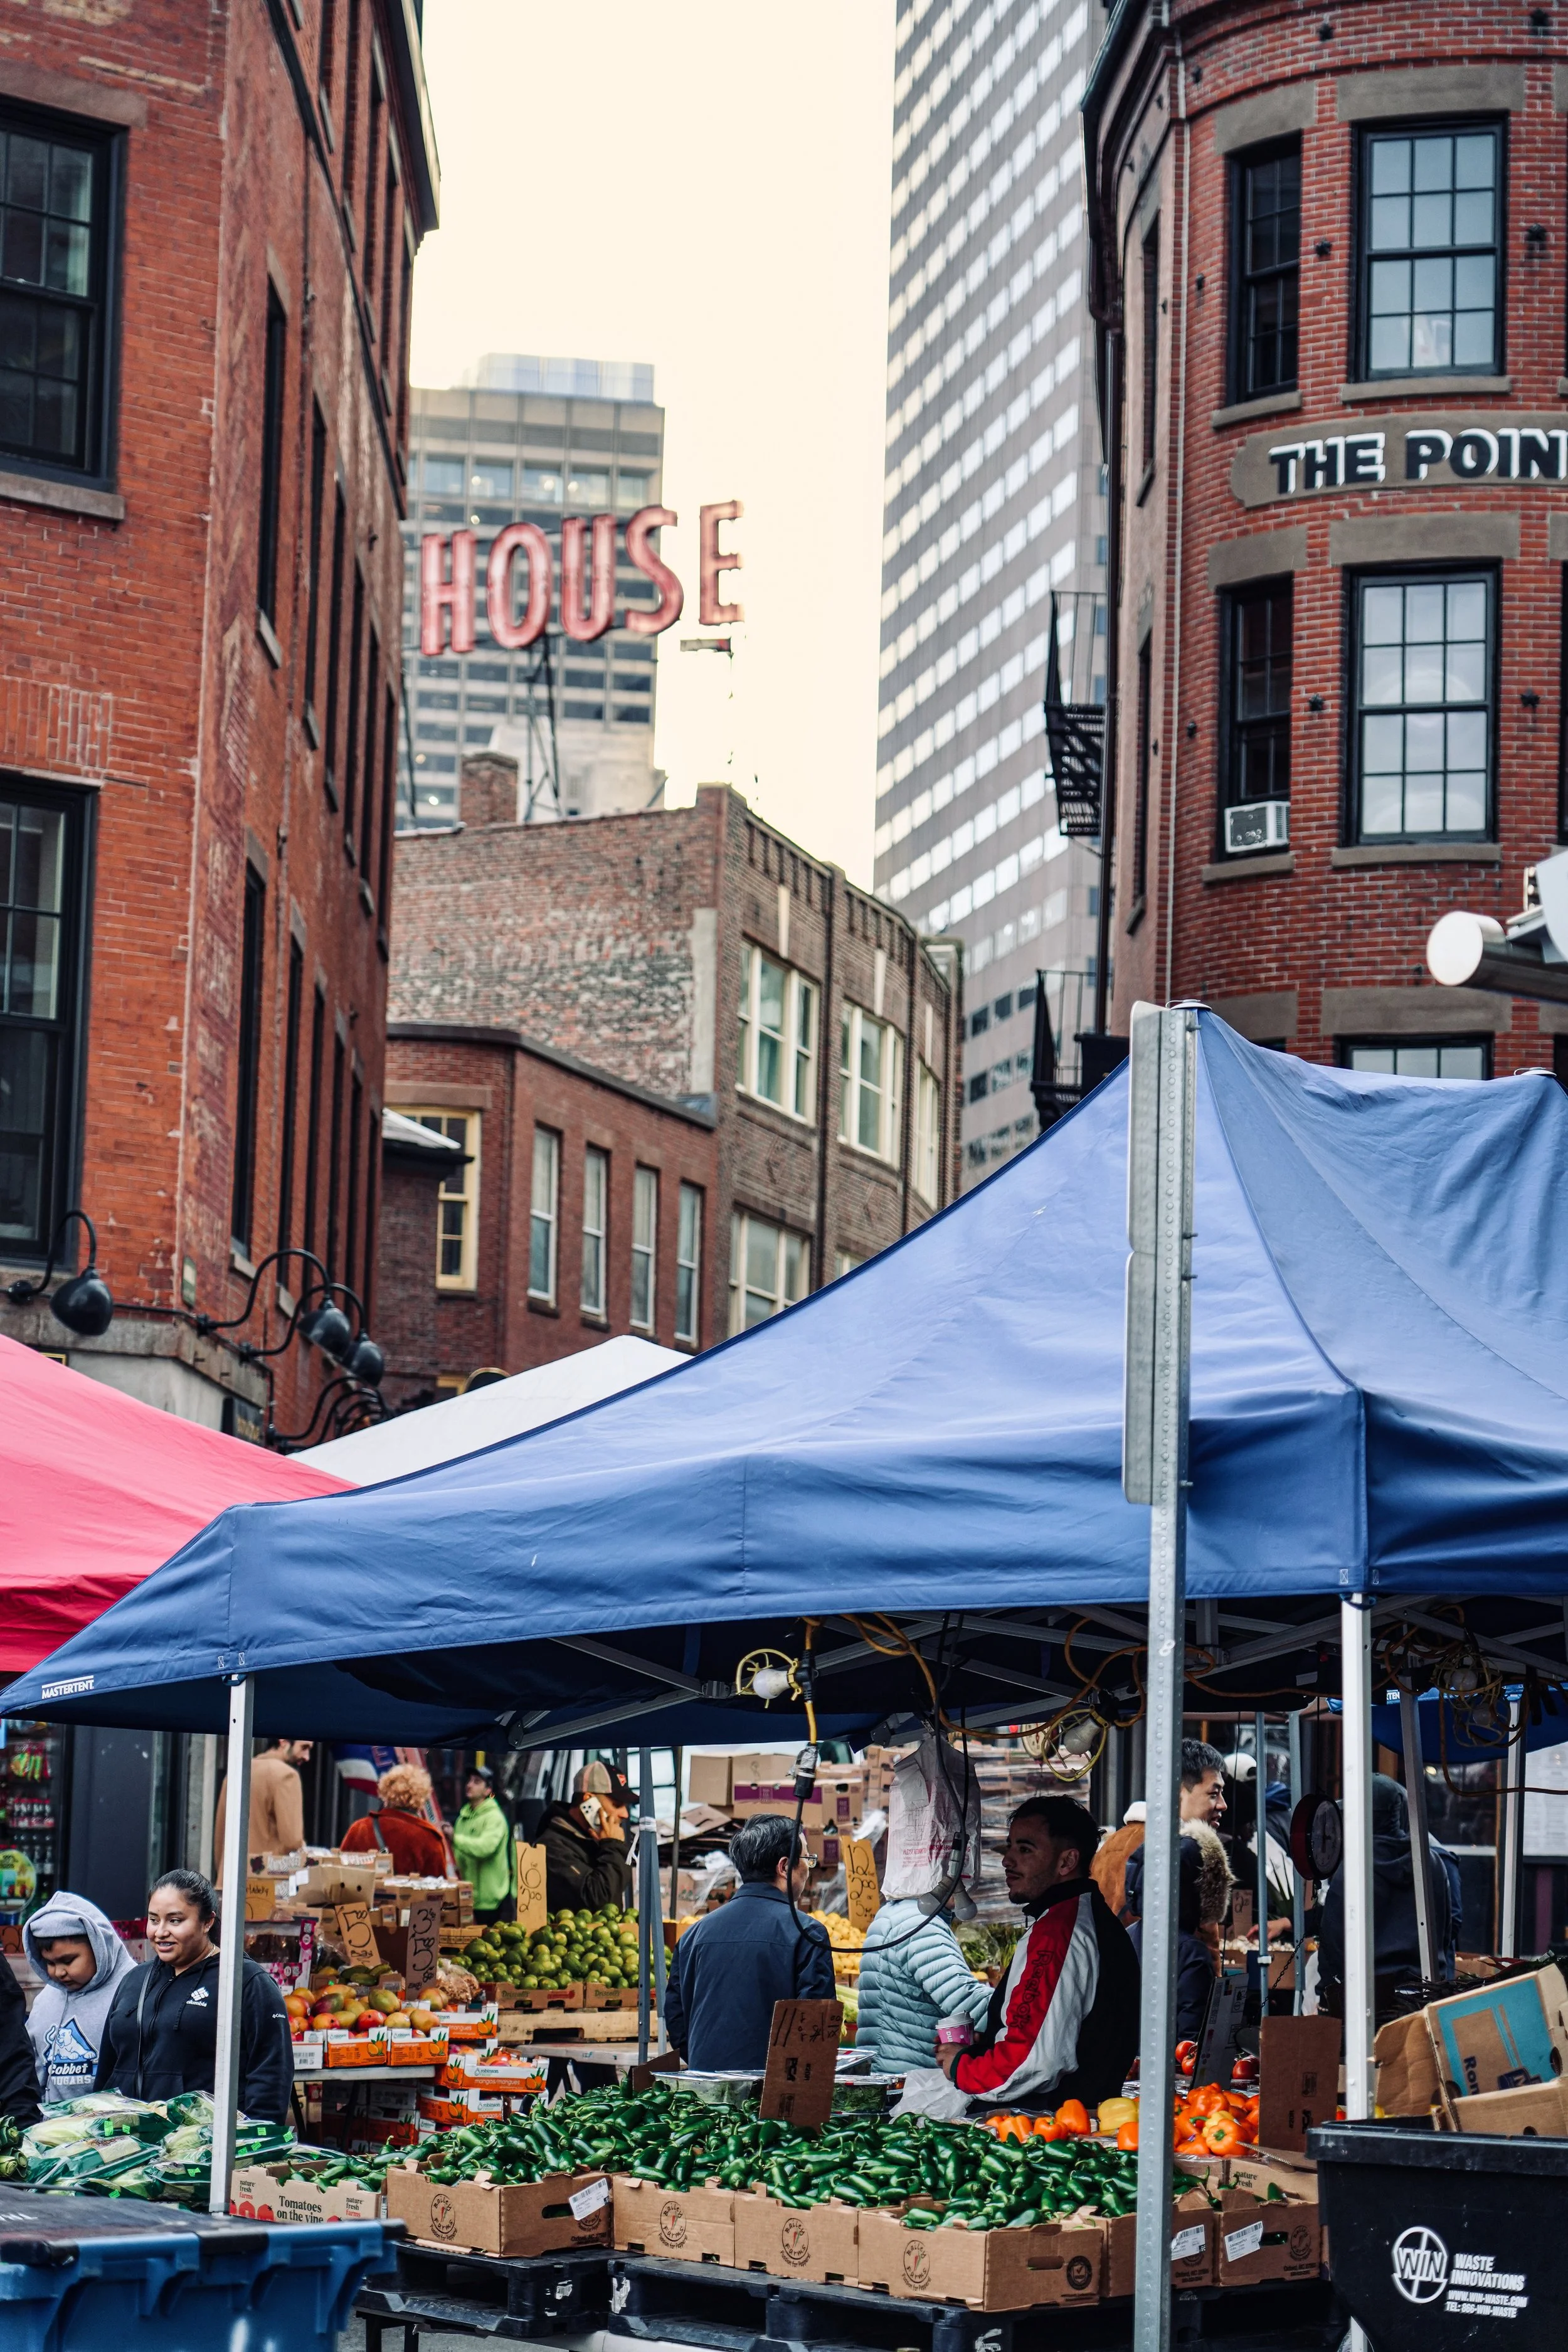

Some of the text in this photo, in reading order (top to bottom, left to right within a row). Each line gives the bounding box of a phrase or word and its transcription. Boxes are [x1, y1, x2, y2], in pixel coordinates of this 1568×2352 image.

[1268, 428, 1568, 495] THE POIN
[420, 499, 745, 656] HOUSE
[41, 1680, 94, 1699] MASTERTENT
[1010, 1950, 1054, 2030] Reebok
[48, 2063, 88, 2075] Cobbet
[279, 2196, 322, 2213] Tomatoes
[346, 2210, 361, 2218] farms
[277, 2210, 324, 2223] on the vine
[1399, 2247, 1443, 2283] WIN
[1454, 2253, 1495, 2272] WASTE
[1449, 2269, 1525, 2292] INNOVATIONS
[1448, 2290, 1528, 2308] WWW.WIN-WASTE.COM
[1445, 2301, 1518, 2318] TEL: 866-WIN-WASTE
